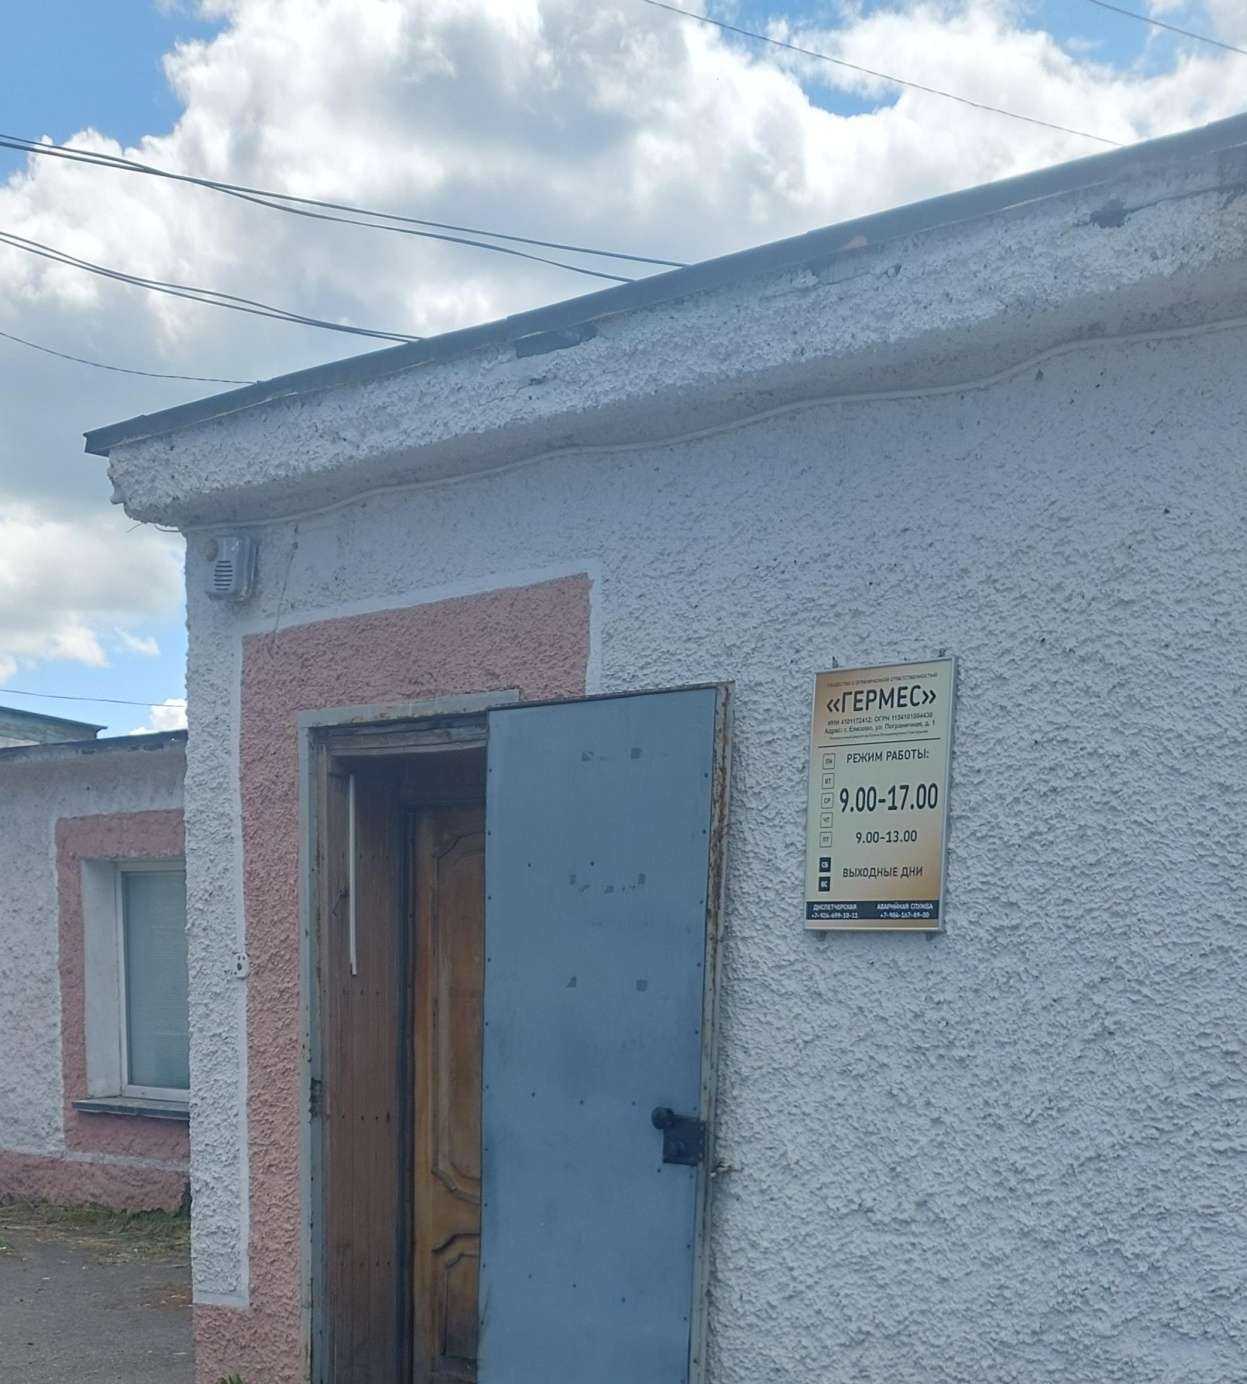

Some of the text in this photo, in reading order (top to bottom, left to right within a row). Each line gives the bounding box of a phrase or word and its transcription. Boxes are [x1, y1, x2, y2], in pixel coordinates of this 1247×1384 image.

[826, 685, 936, 712] «ГЕРМЕС»
[846, 748, 930, 764] РЕЖИМ РАБОТЫ:
[840, 783, 938, 813] 9.00-17.00
[856, 830, 917, 843] 9.00-13.00
[843, 866, 923, 878] ВЫХОДНЫЕ ДНИ
